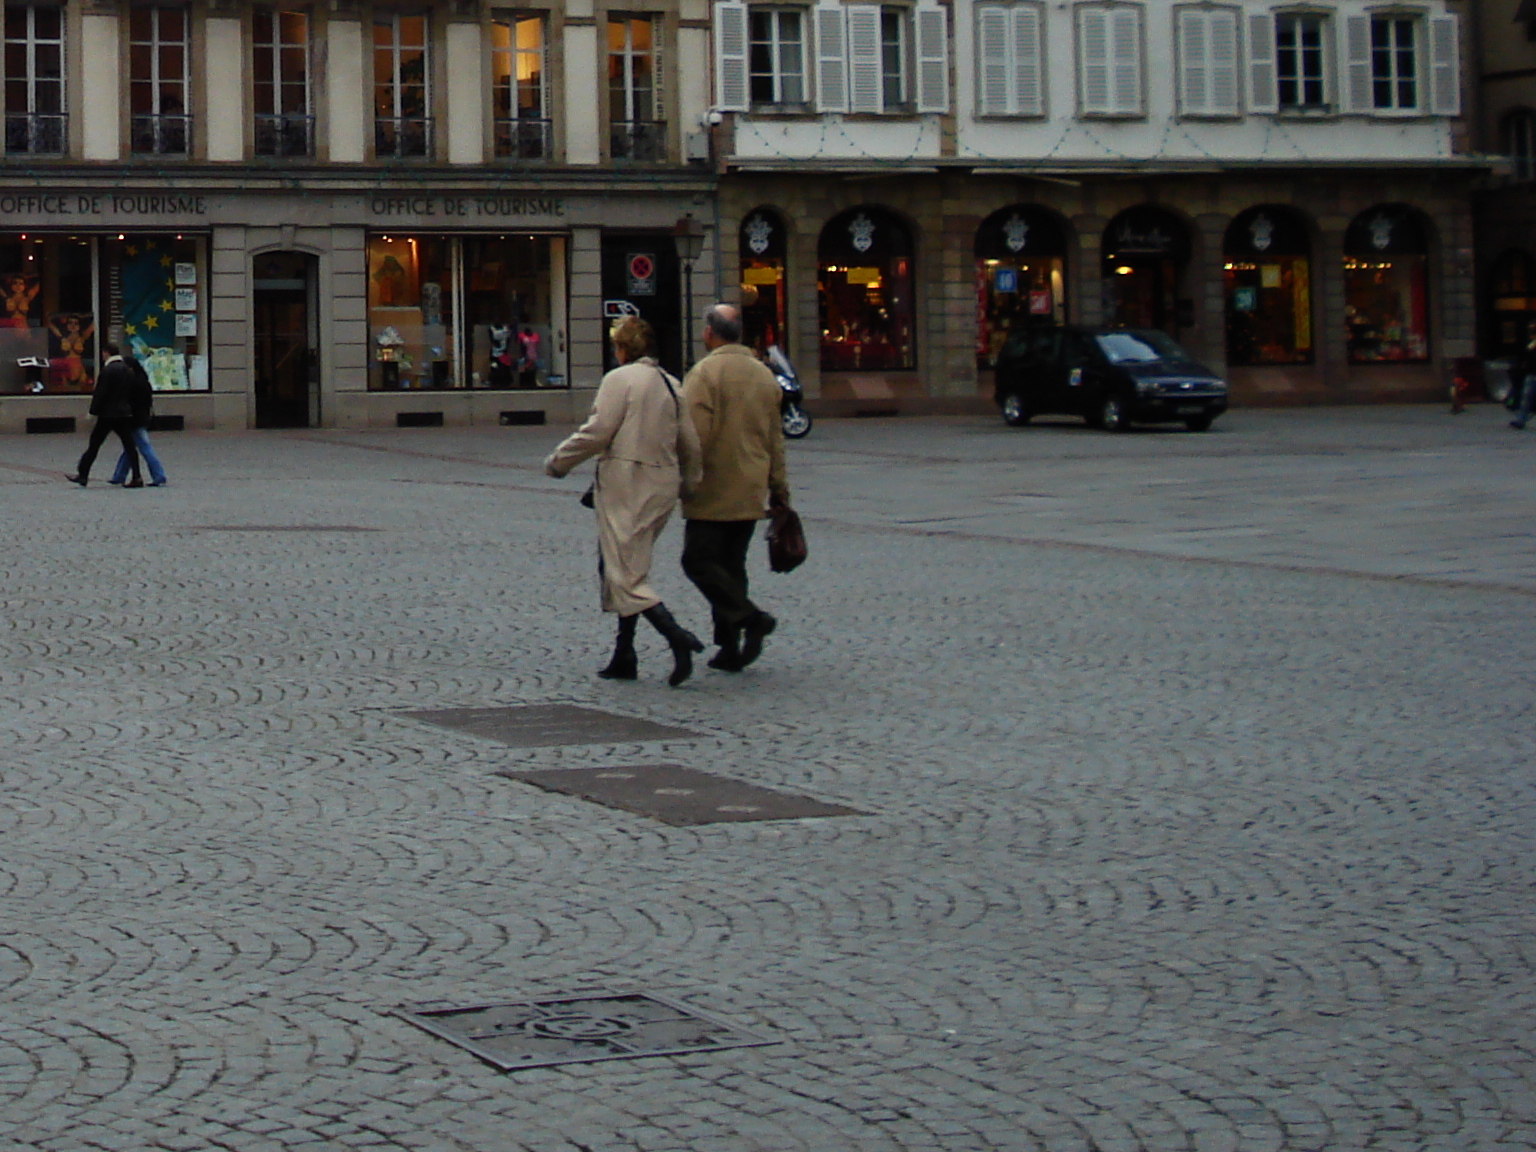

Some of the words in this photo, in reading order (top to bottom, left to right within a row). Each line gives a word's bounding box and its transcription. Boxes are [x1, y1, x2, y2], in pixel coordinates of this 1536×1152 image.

[0, 195, 69, 214] OFFICE
[77, 196, 101, 214] DE
[112, 196, 205, 214] TOURISME
[371, 198, 436, 215] OFFICE
[444, 198, 466, 216] DE
[474, 198, 565, 216] TOURISME
